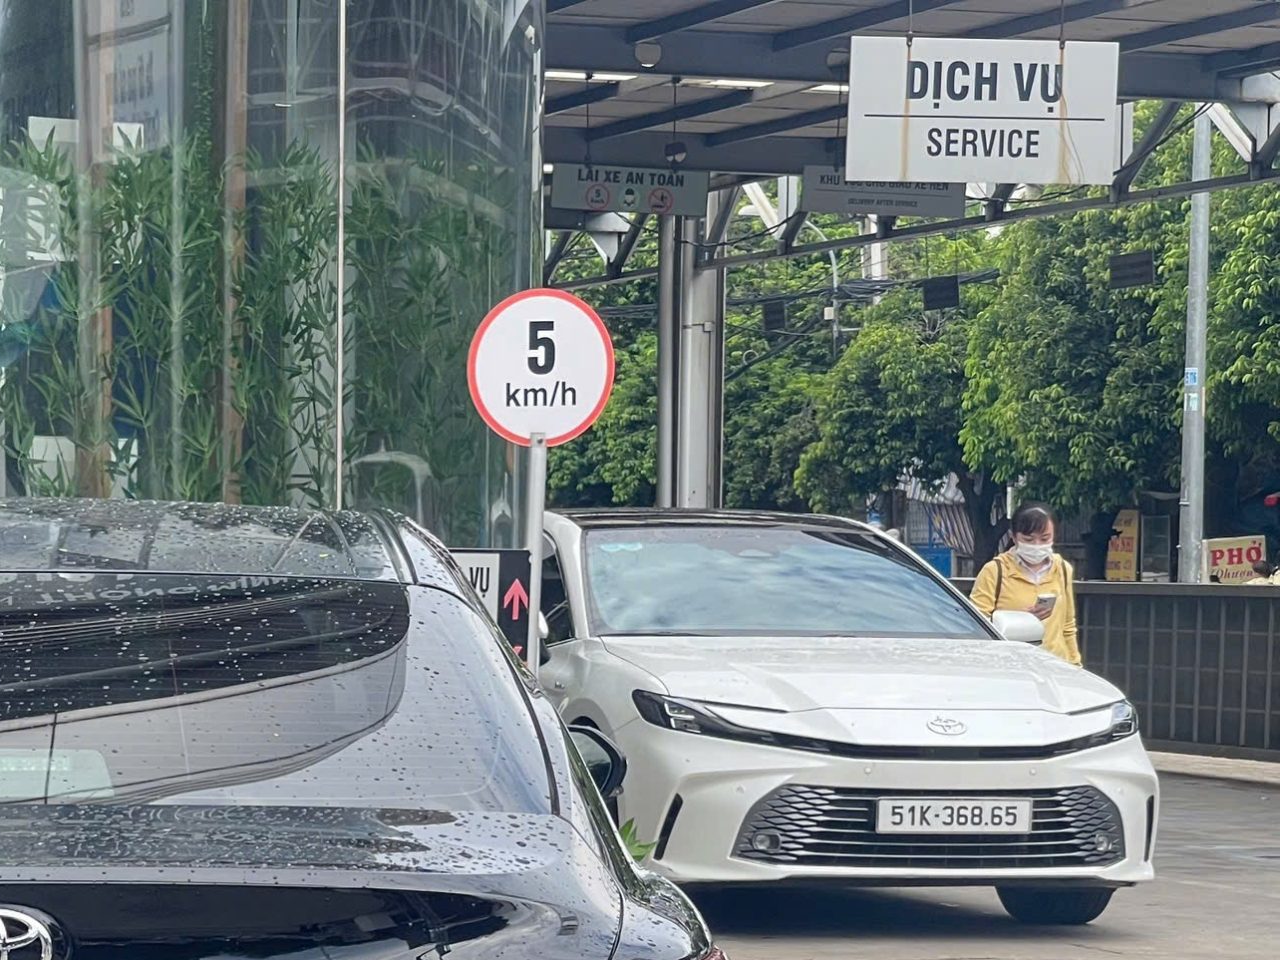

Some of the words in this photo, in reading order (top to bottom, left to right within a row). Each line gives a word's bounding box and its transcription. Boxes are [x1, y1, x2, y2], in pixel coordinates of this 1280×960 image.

[907, 60, 999, 109] DỊCH
[1013, 62, 1063, 113] VỤ
[926, 127, 1040, 158] SERVICE
[603, 170, 622, 183] XE
[625, 171, 645, 185] AN
[819, 174, 841, 187] KHU
[527, 321, 555, 375] 5
[506, 381, 577, 407] km/h
[469, 566, 490, 598] VỤ
[891, 805, 1018, 826] 51K-368.65
